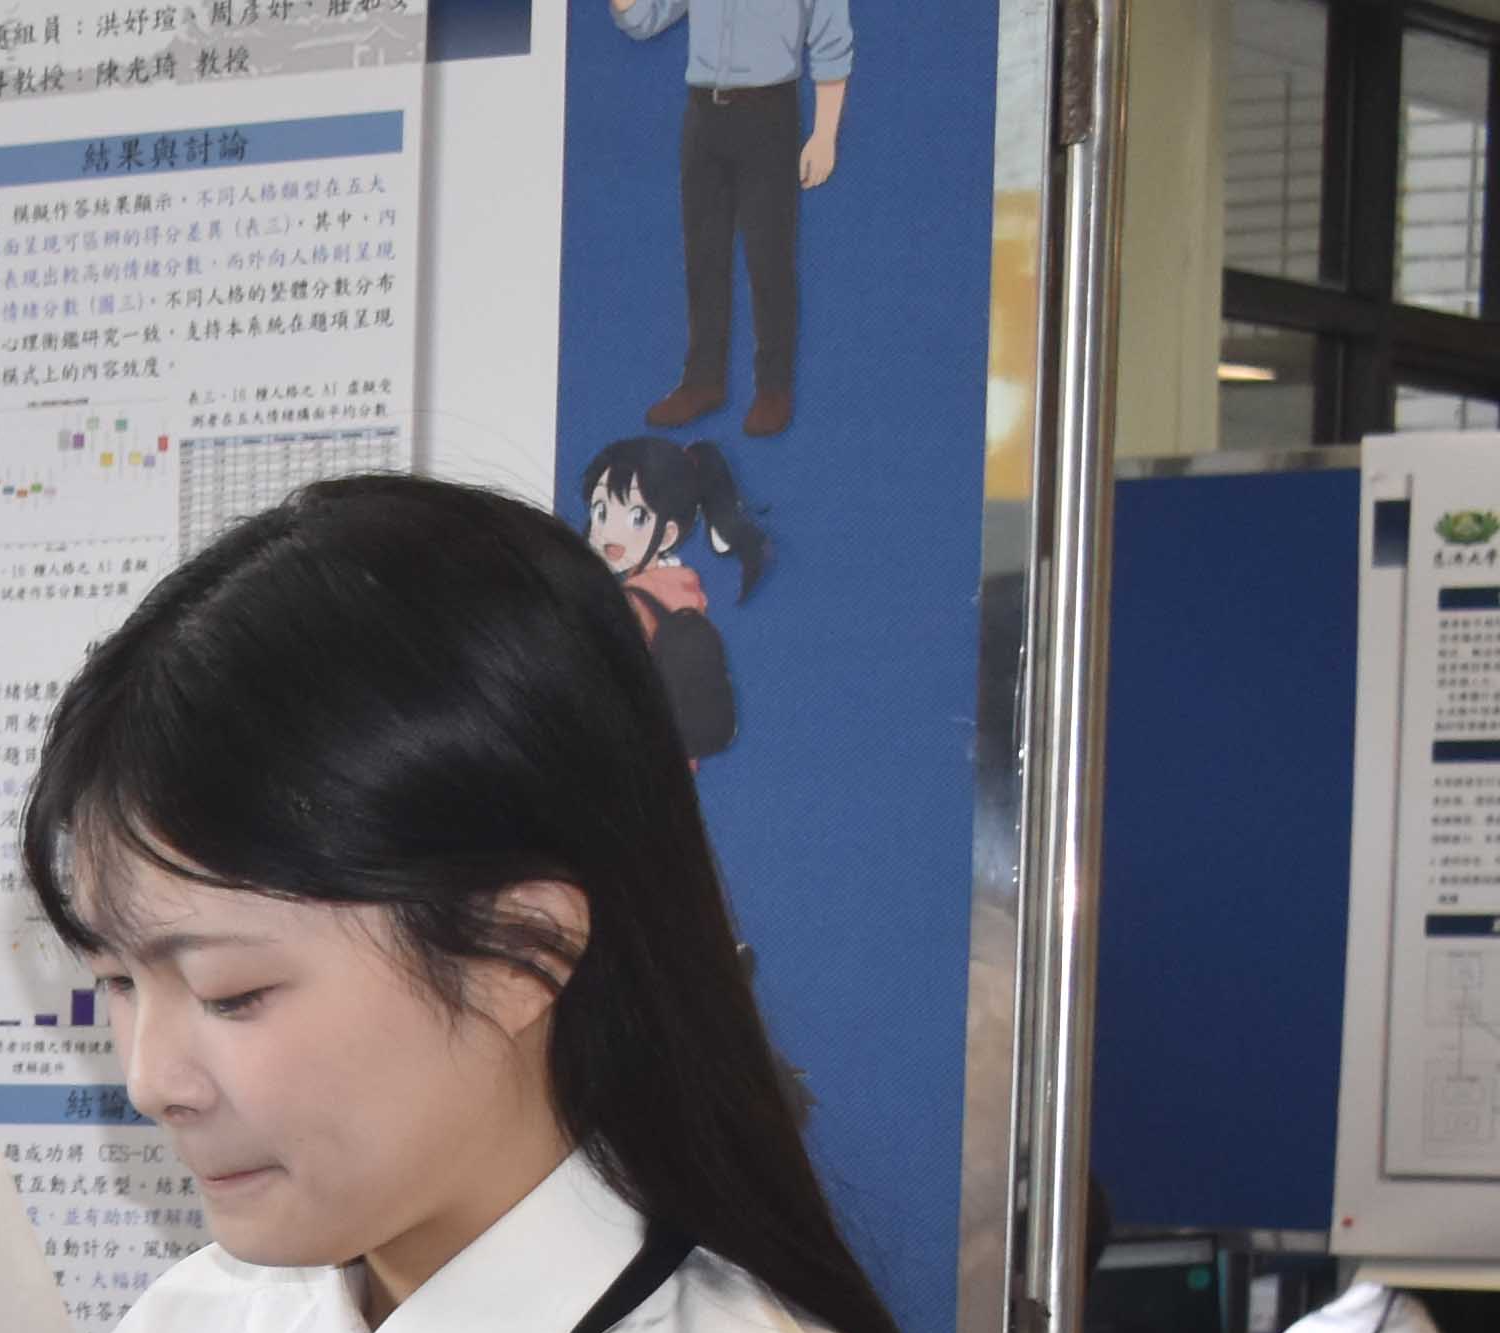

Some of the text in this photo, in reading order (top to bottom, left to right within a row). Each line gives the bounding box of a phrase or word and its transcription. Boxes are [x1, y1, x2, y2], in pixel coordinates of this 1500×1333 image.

[198, 47, 250, 77] 教授
[81, 127, 250, 175] 結果與討論
[98, 1144, 164, 1163] CES-DC
